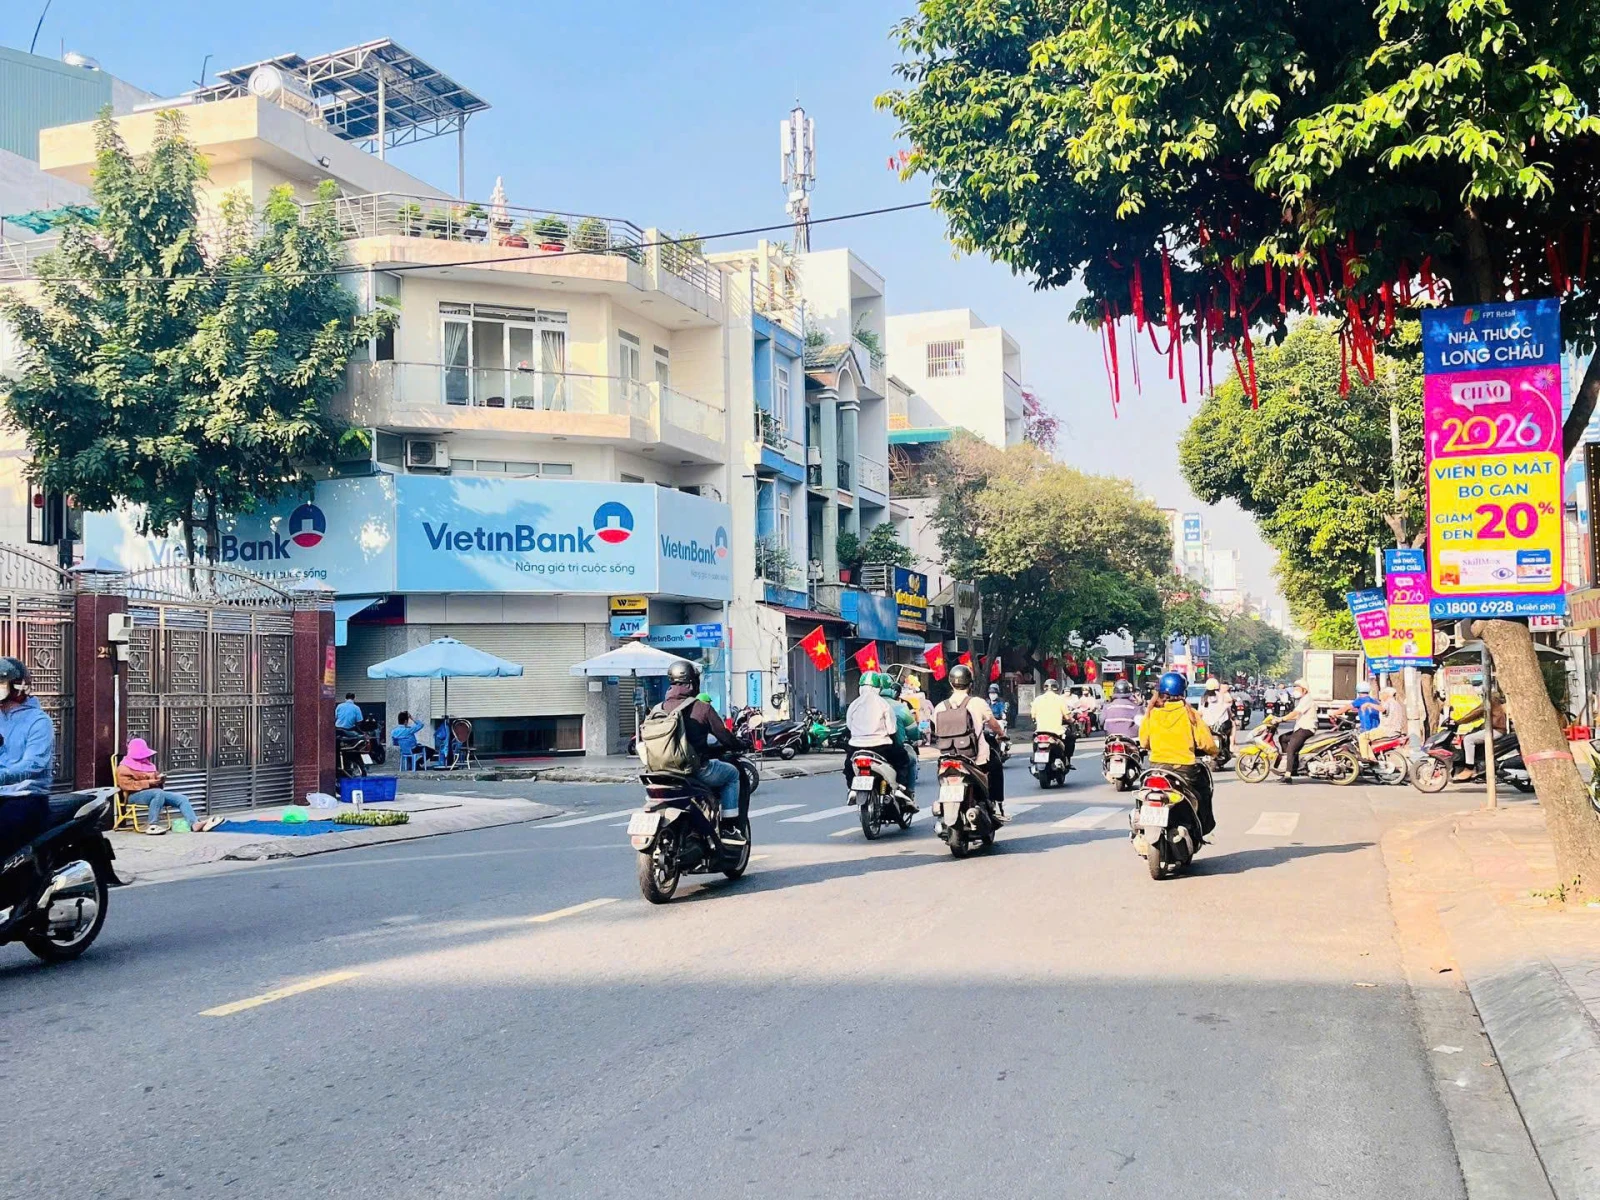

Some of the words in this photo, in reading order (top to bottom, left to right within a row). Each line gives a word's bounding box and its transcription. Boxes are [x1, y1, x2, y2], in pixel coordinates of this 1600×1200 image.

[1482, 311, 1495, 319] FPT
[1496, 309, 1516, 318] Retail
[1448, 328, 1479, 345] NHÀ
[1482, 322, 1532, 342] THUỐC
[1441, 347, 1491, 366] LONG
[1494, 342, 1544, 361] CHÂU
[1460, 383, 1505, 400] CHÀO
[1442, 412, 1542, 452] 2026
[1489, 483, 1529, 497] GAN
[422, 522, 596, 554] VietinBank
[660, 534, 717, 565] VietinBank
[515, 561, 545, 574] Nâng
[548, 562, 565, 574] giá
[568, 563, 579, 575] trị
[581, 563, 608, 575] cuộc
[609, 561, 635, 575] sống
[1393, 589, 1424, 604] 2026
[1446, 601, 1478, 614] 1800
[1480, 600, 1514, 613] 6928
[619, 622, 640, 632] ATM
[1391, 628, 1414, 640] 206
